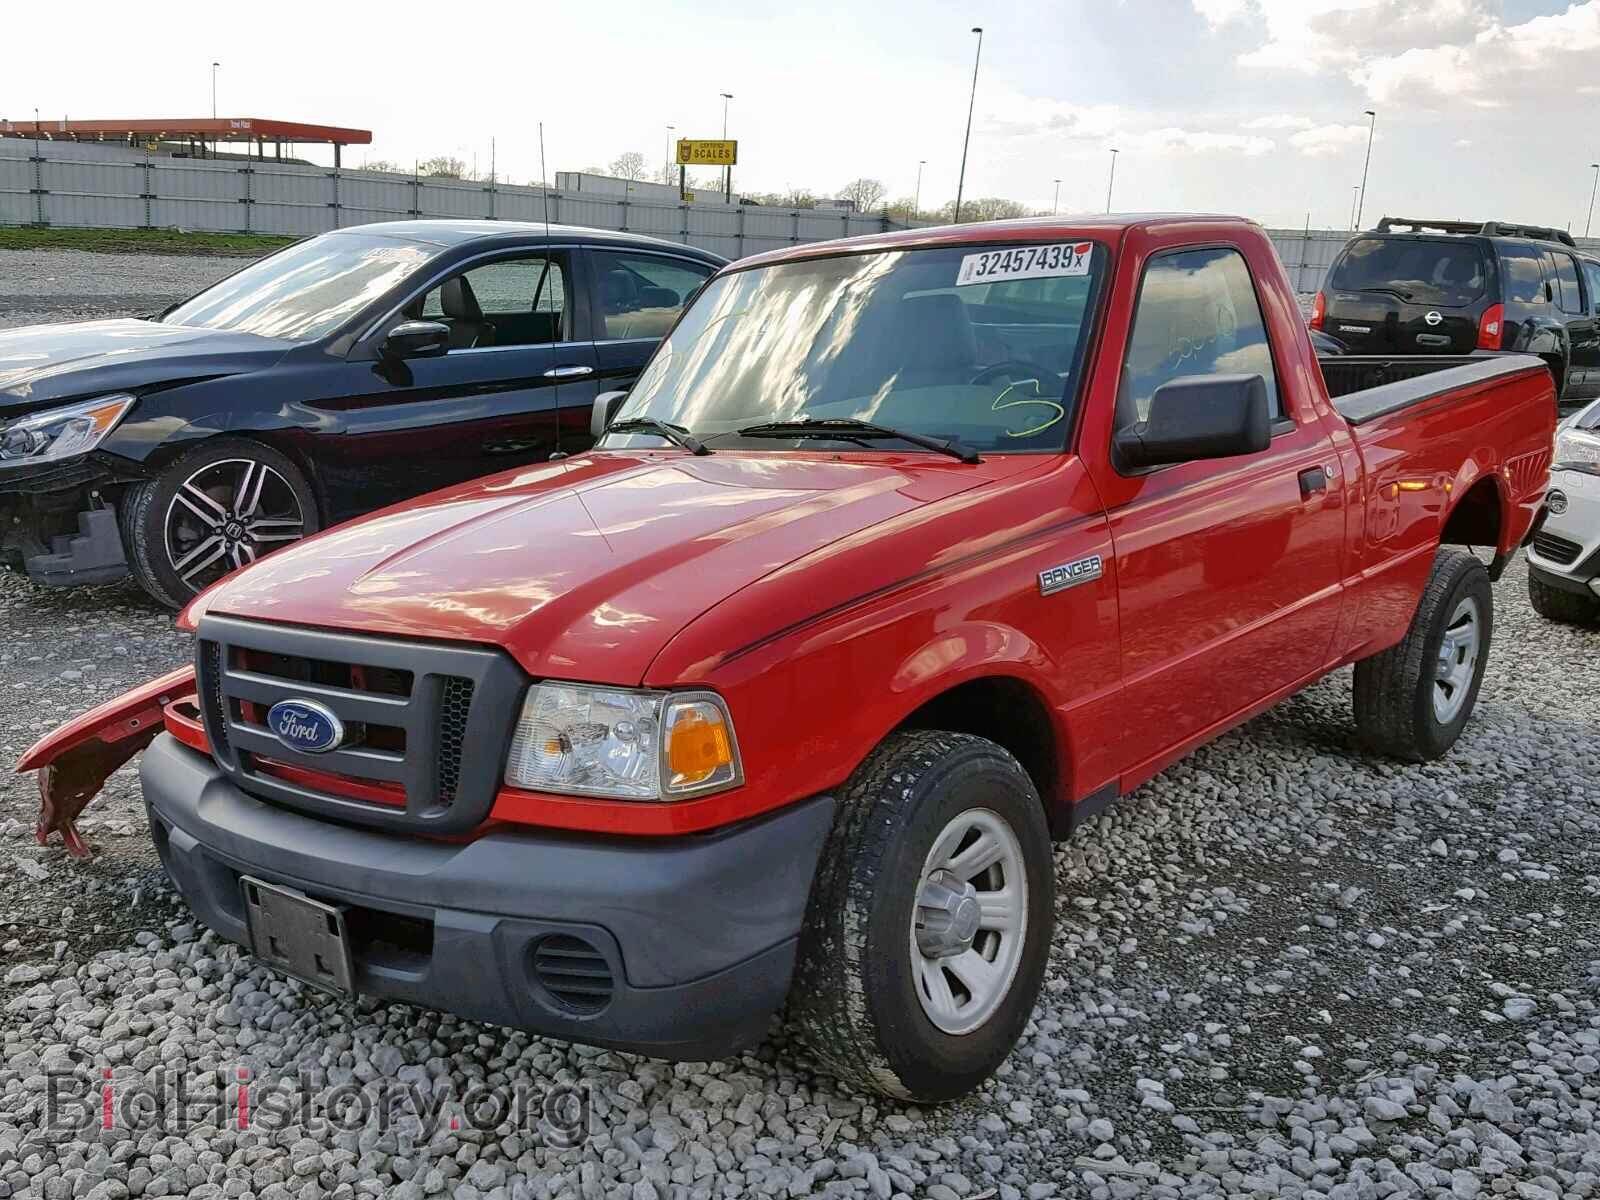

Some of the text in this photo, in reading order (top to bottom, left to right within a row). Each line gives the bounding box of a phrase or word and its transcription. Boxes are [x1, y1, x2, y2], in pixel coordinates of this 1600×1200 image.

[694, 149, 730, 159] SCALES
[976, 246, 1074, 276] 32457439
[1041, 557, 1100, 587] RANGER
[279, 708, 319, 741] Ford
